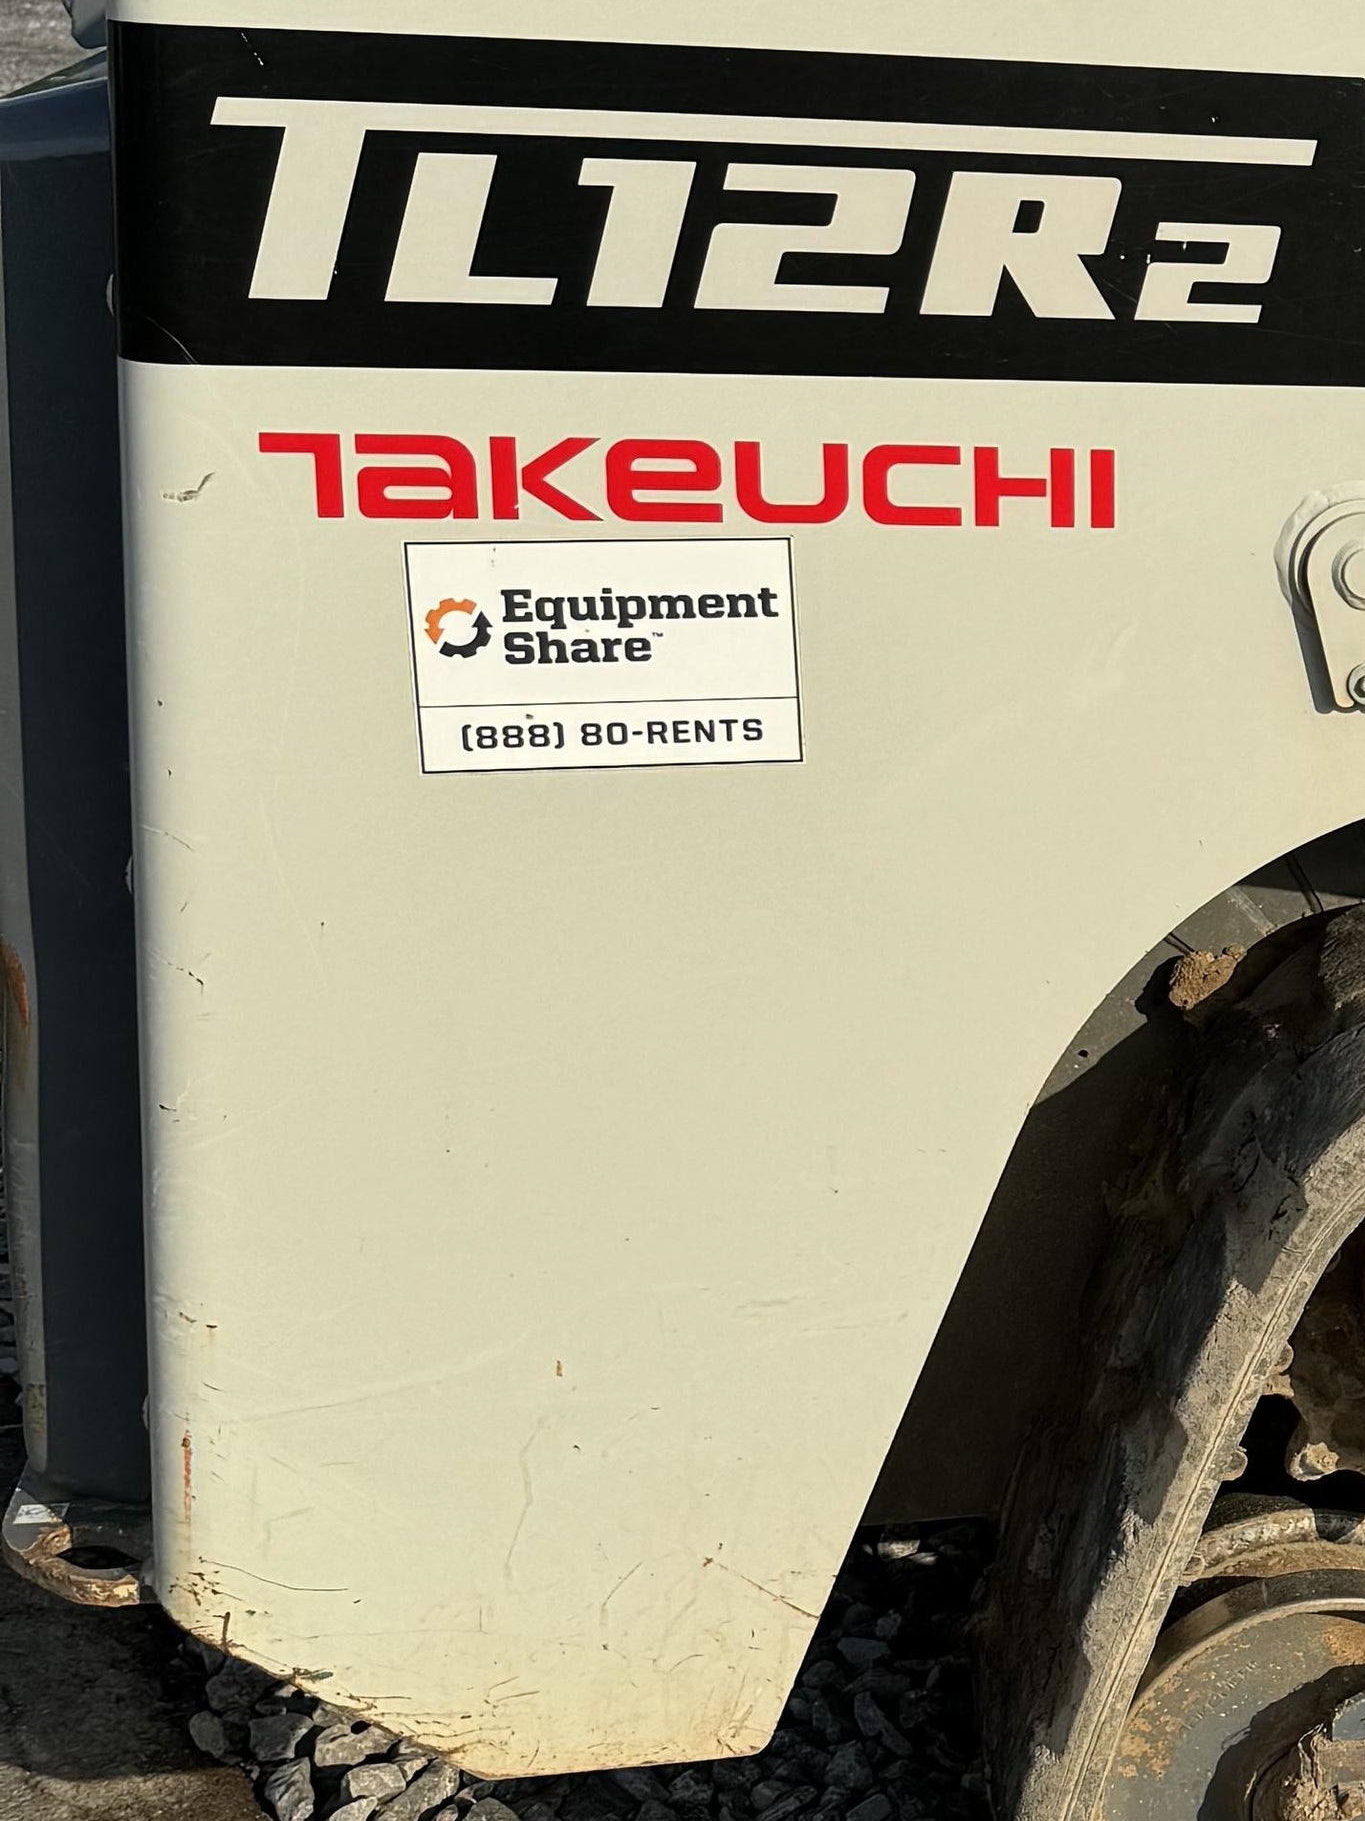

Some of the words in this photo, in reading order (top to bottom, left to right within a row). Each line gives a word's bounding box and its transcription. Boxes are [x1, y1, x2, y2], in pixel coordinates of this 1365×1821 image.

[211, 97, 1318, 323] TL12R2
[500, 587, 779, 629] Equipment
[461, 721, 565, 752] (888)
[581, 718, 763, 746] 80-RENTS
